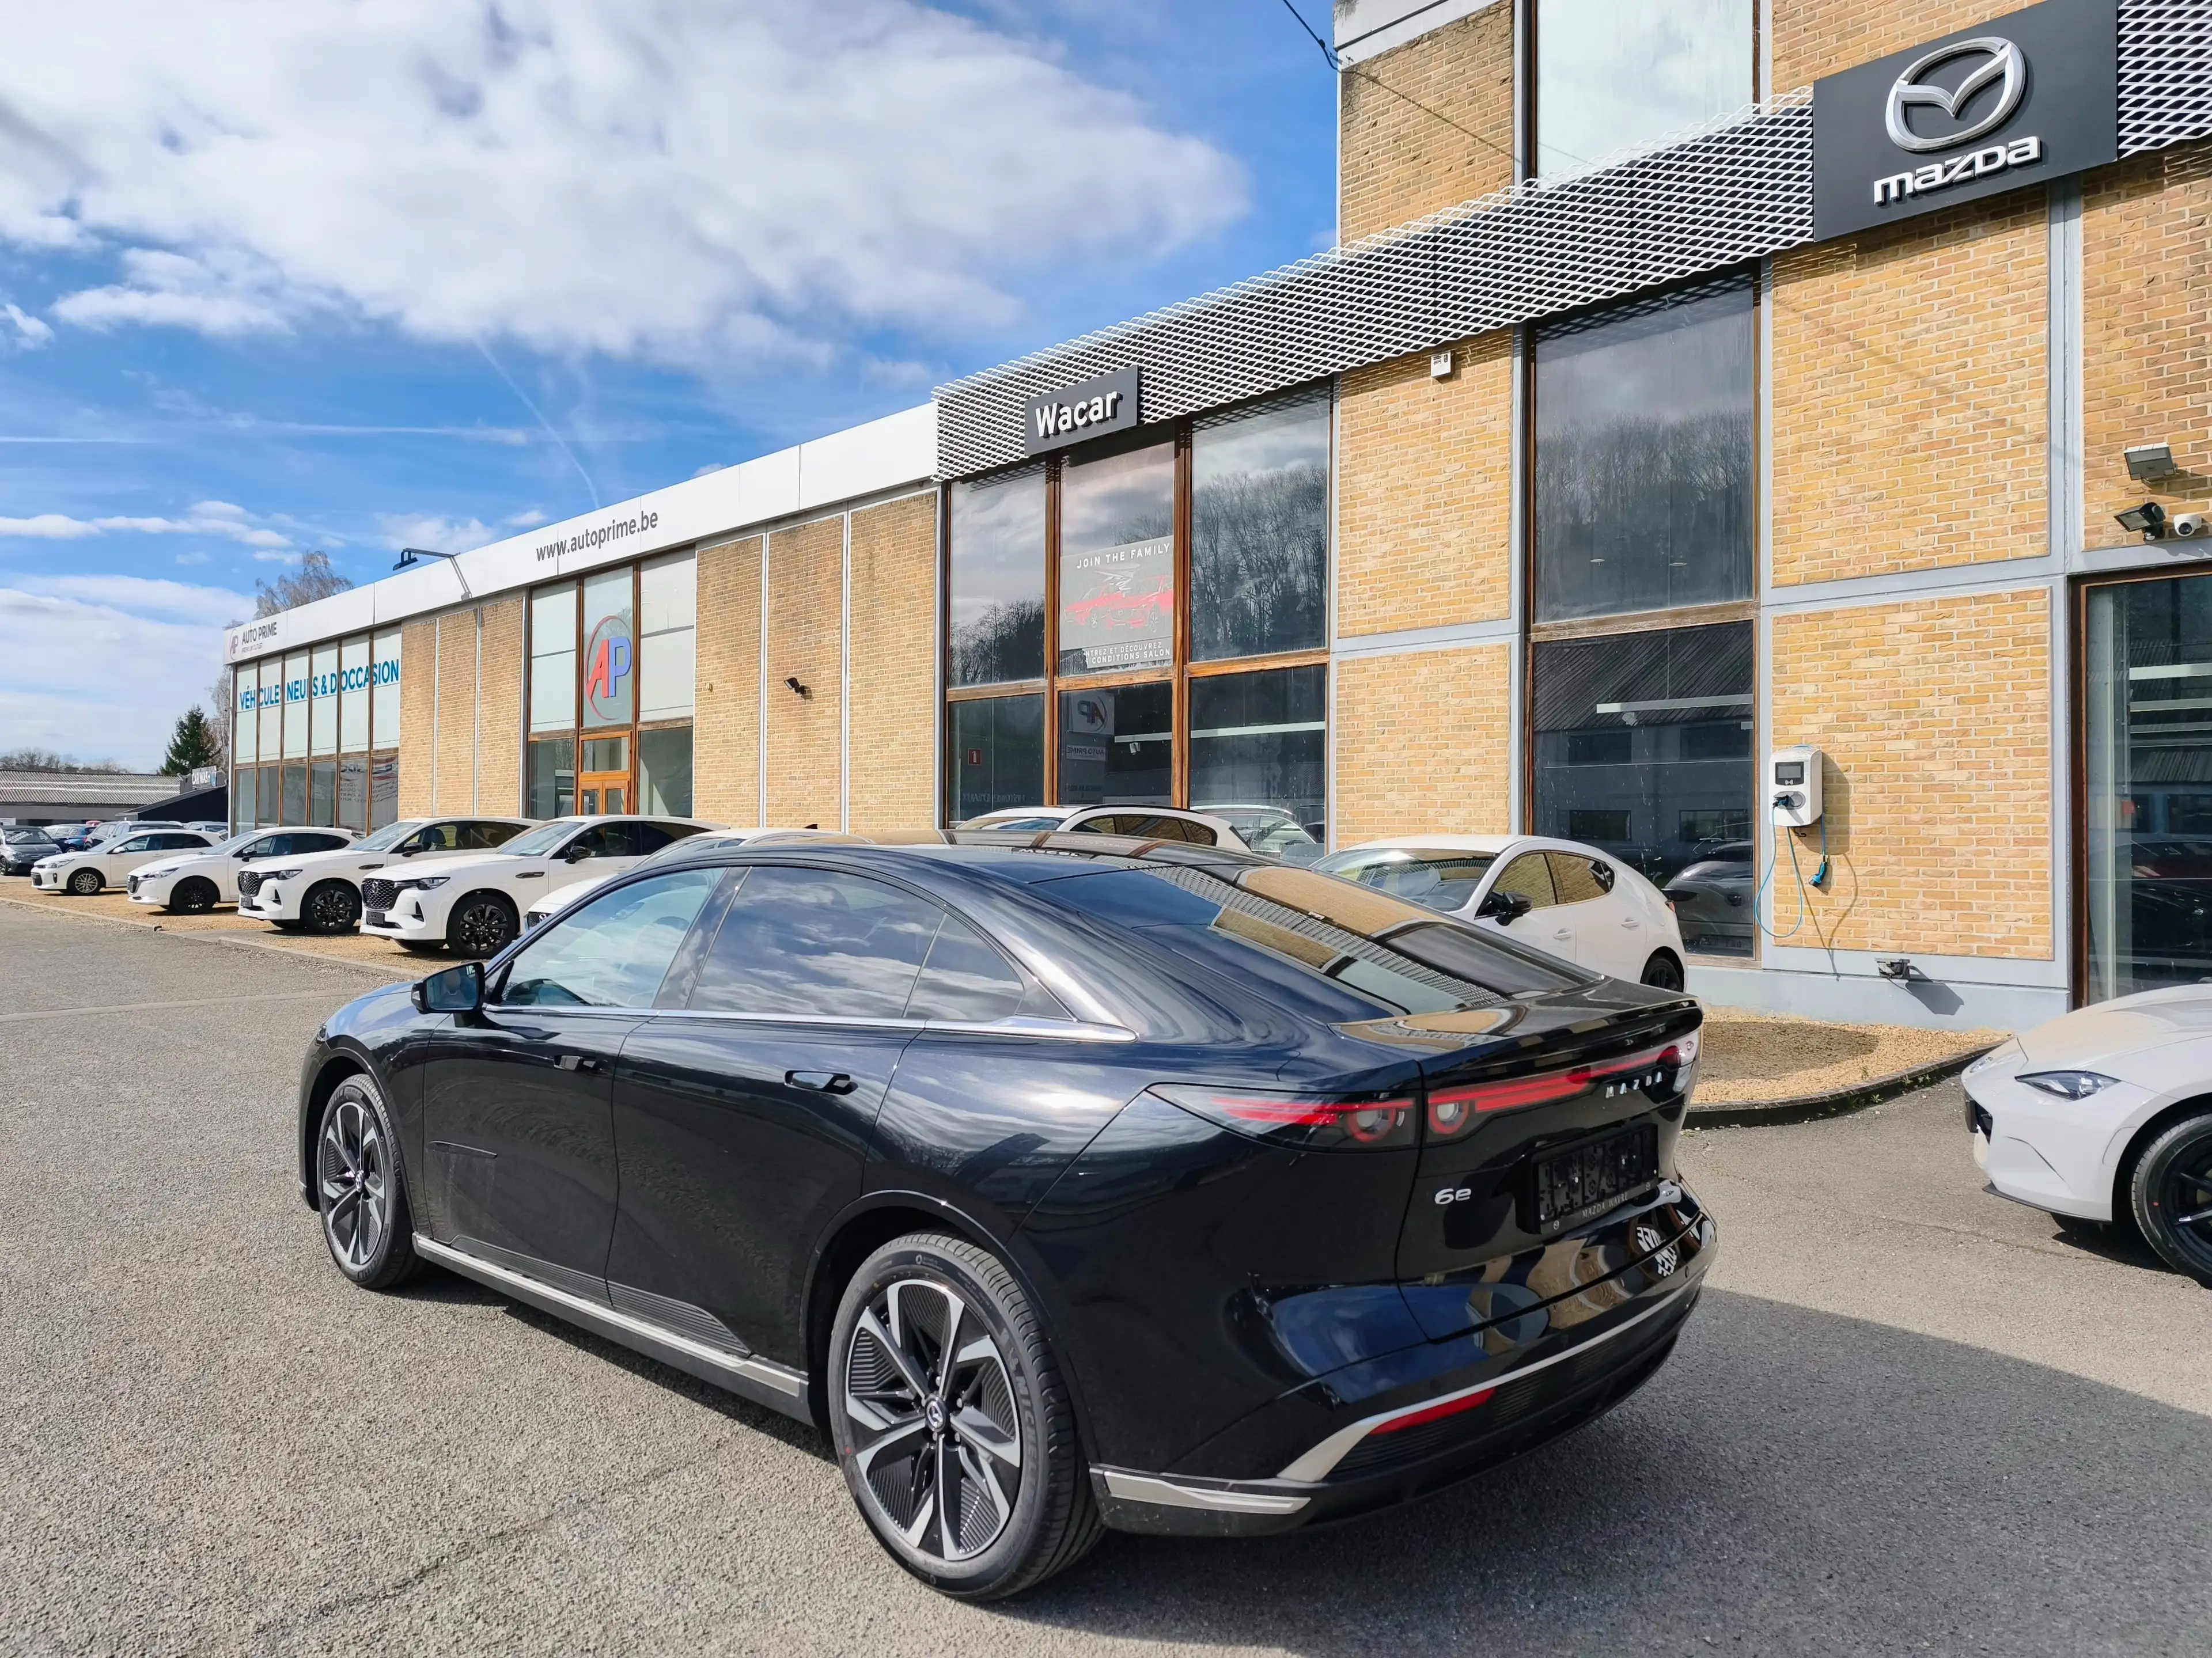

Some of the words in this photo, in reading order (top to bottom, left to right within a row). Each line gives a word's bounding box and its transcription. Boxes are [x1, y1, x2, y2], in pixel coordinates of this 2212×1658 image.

[1874, 136, 2040, 204] mazda
[1035, 391, 1120, 438] Wacar
[536, 510, 658, 561] www.autoprime.be
[1077, 556, 1101, 569] JOIN
[1105, 551, 1126, 563] THE
[1131, 543, 1170, 559] FAMILY
[242, 628, 257, 645] AUTO
[258, 621, 277, 640] PRIME
[1084, 648, 1107, 658] NTREZ
[1120, 642, 1162, 652] DÉCOUVREZ
[1092, 652, 1139, 665] CONDITIONS
[1143, 648, 1171, 658] SALON
[586, 636, 632, 699] AP
[240, 684, 281, 710] VÉHCULE
[321, 674, 327, 695] &
[1605, 1071, 1663, 1098] MAZDA
[1434, 1188, 1472, 1205] 6e
[1582, 1202, 1605, 1219] MAZDA
